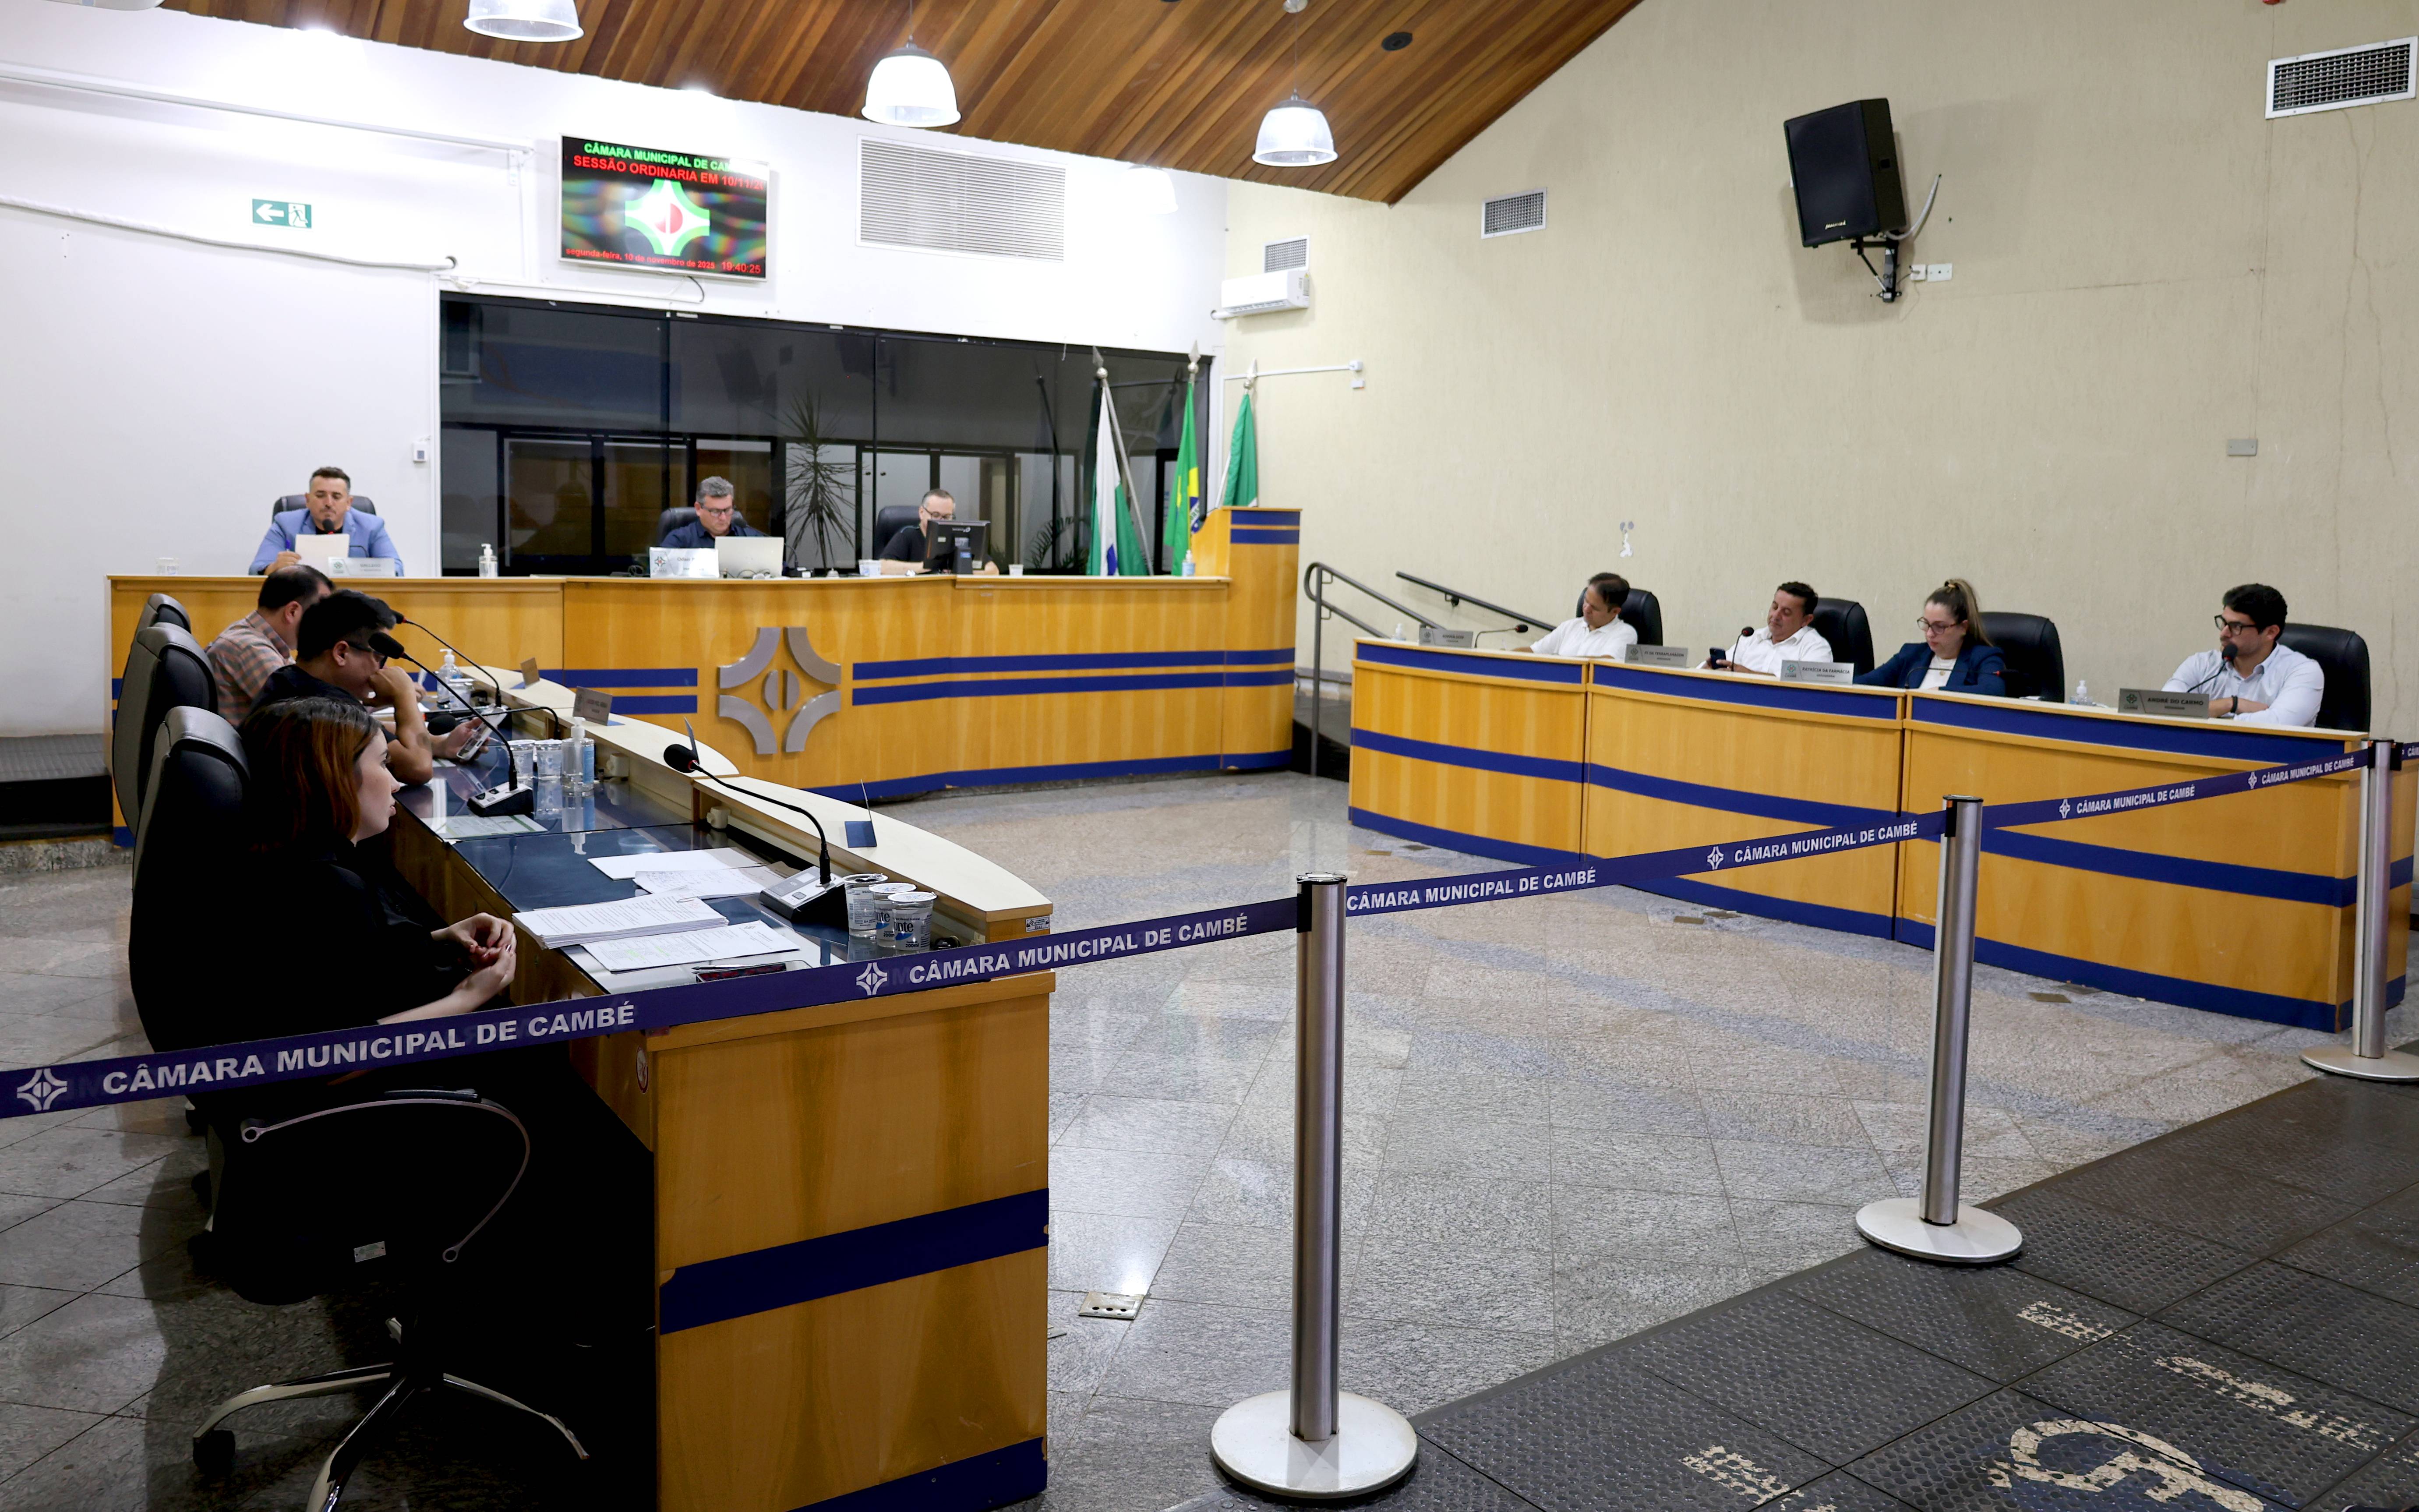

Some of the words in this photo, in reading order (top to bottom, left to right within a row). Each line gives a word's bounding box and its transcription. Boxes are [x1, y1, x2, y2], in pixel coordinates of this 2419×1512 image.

[574, 155, 627, 172] SESSÃO
[629, 163, 698, 181] ORDINARIA
[701, 171, 719, 184] EM
[584, 142, 632, 159] CÂMARA
[634, 150, 692, 168] MUNICIPAL
[694, 158, 708, 170] DE
[647, 256, 685, 266] novembro
[2261, 770, 2289, 784] CÂMARA
[2290, 764, 2323, 779] MUNICIPAL
[2324, 761, 2333, 772] DE
[2333, 756, 2355, 770] CAMBÉ
[2076, 799, 2111, 814] CÂMARA
[2113, 792, 2155, 809] MUNICIPAL
[2157, 790, 2168, 802] DE
[2169, 784, 2195, 800] CAMBÉ
[1734, 845, 1787, 863] CÂMARA
[1791, 834, 1857, 855] MUNICIPAL
[1859, 829, 1875, 844] DE
[1878, 820, 1918, 841] CAMBÉ
[1346, 890, 1420, 911] CÂMARA
[1425, 880, 1514, 903] MUNICIPAL
[1518, 876, 1539, 893] DE
[1543, 866, 1596, 889] CAMBÉ
[909, 953, 1010, 984] CÂMARA
[1018, 934, 1138, 968] MUNICIPAL
[1144, 928, 1171, 947] DE
[1178, 912, 1248, 942] CAMBÉ
[102, 1054, 265, 1095] CÂMARA
[277, 1028, 465, 1073] MUNICIPAL
[477, 1020, 517, 1046] DE
[528, 1000, 635, 1037] CAMBÉ
